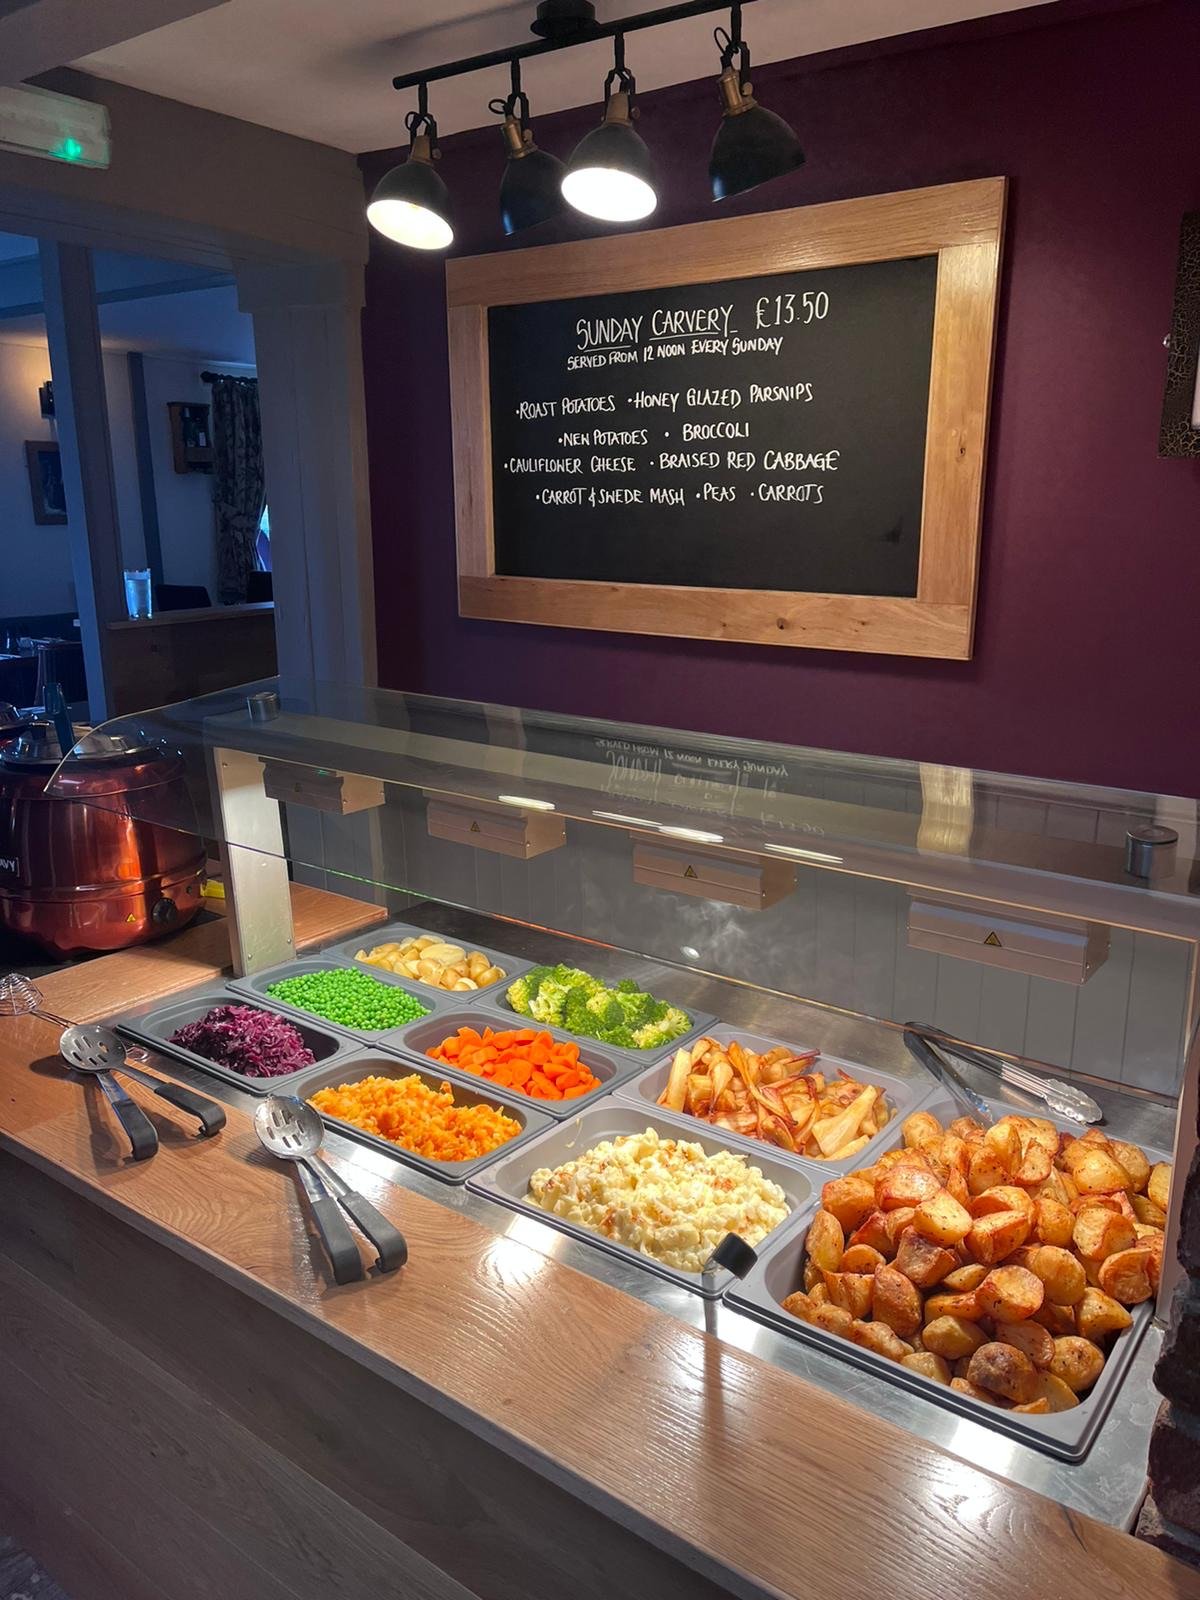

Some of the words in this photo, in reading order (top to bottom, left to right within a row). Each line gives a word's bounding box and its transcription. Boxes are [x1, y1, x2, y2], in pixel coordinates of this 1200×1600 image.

[577, 316, 643, 350] SUNDAY
[651, 305, 734, 335] CARVERY
[756, 292, 828, 329] £13.50
[568, 355, 606, 370] SERVED
[609, 351, 638, 364] FROM
[644, 347, 654, 362] 12
[657, 344, 685, 358] NOON
[691, 339, 729, 356] EVERY
[731, 337, 783, 355] SUNDAY
[520, 401, 557, 419] ROAST
[562, 395, 615, 415] POTATOES
[634, 391, 679, 412] HONEY
[687, 388, 741, 409] GLAZED
[750, 383, 813, 403] PARSNIPS
[564, 433, 590, 446] NEW
[593, 429, 648, 446] POTATOES
[683, 422, 749, 441] BROCCOLI
[510, 458, 583, 473] CAULIFLOWER
[591, 456, 636, 472] CHEESE
[659, 452, 720, 469] BRAISED
[727, 451, 755, 471] RED
[764, 450, 840, 471] CABBAGE
[542, 488, 587, 505] CARROT
[599, 489, 643, 504] SWEDE
[650, 488, 685, 506] MASH
[704, 483, 735, 502] PEAS
[758, 483, 824, 504] CARROTS
